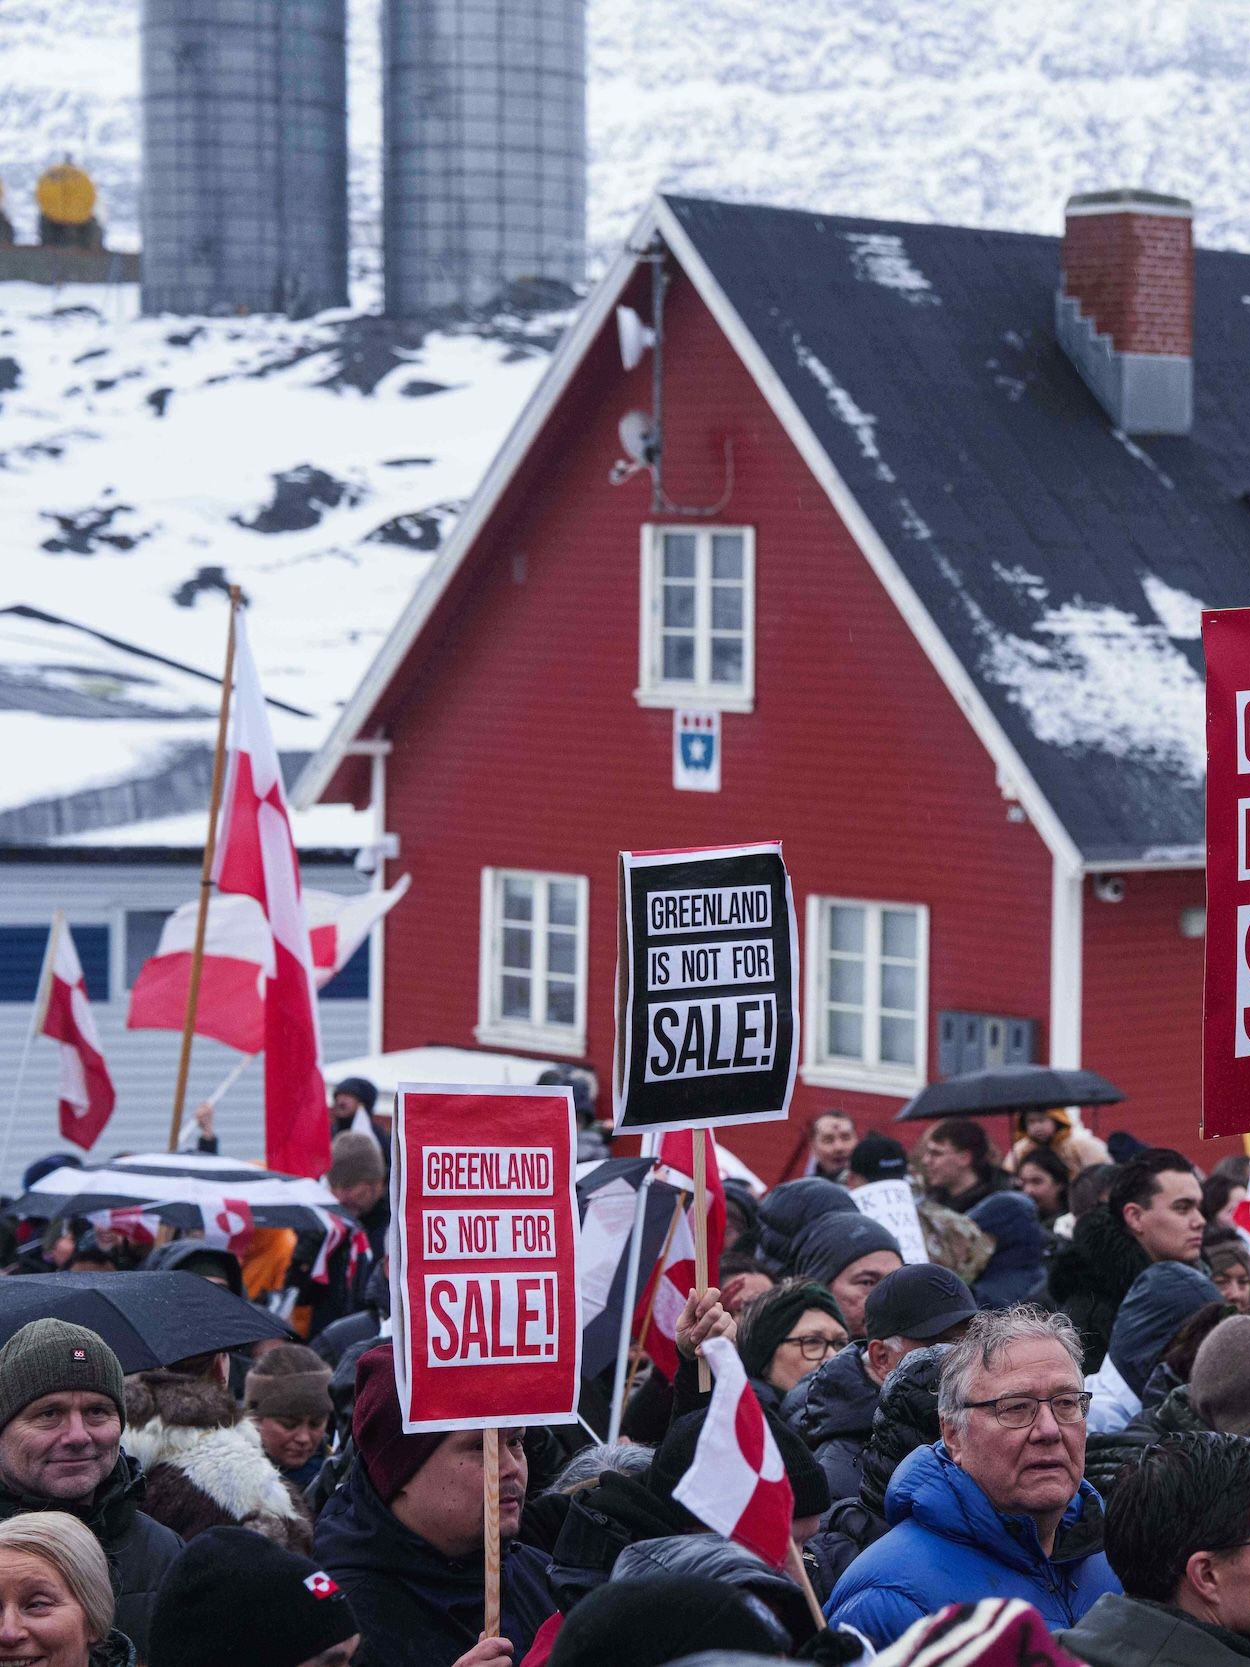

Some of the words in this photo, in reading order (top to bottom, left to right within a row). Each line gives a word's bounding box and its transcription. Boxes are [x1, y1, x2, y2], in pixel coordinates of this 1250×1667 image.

[651, 890, 768, 930] GREENLAND
[651, 951, 670, 986] IS
[681, 947, 722, 983] NOT
[732, 944, 770, 979] FOR
[650, 999, 774, 1077] SALE!
[427, 1151, 550, 1190] GREENLAND
[427, 1215, 448, 1254] IS
[457, 1215, 500, 1253] NOT
[511, 1214, 552, 1253] FOR
[429, 1278, 555, 1362] SALE!
